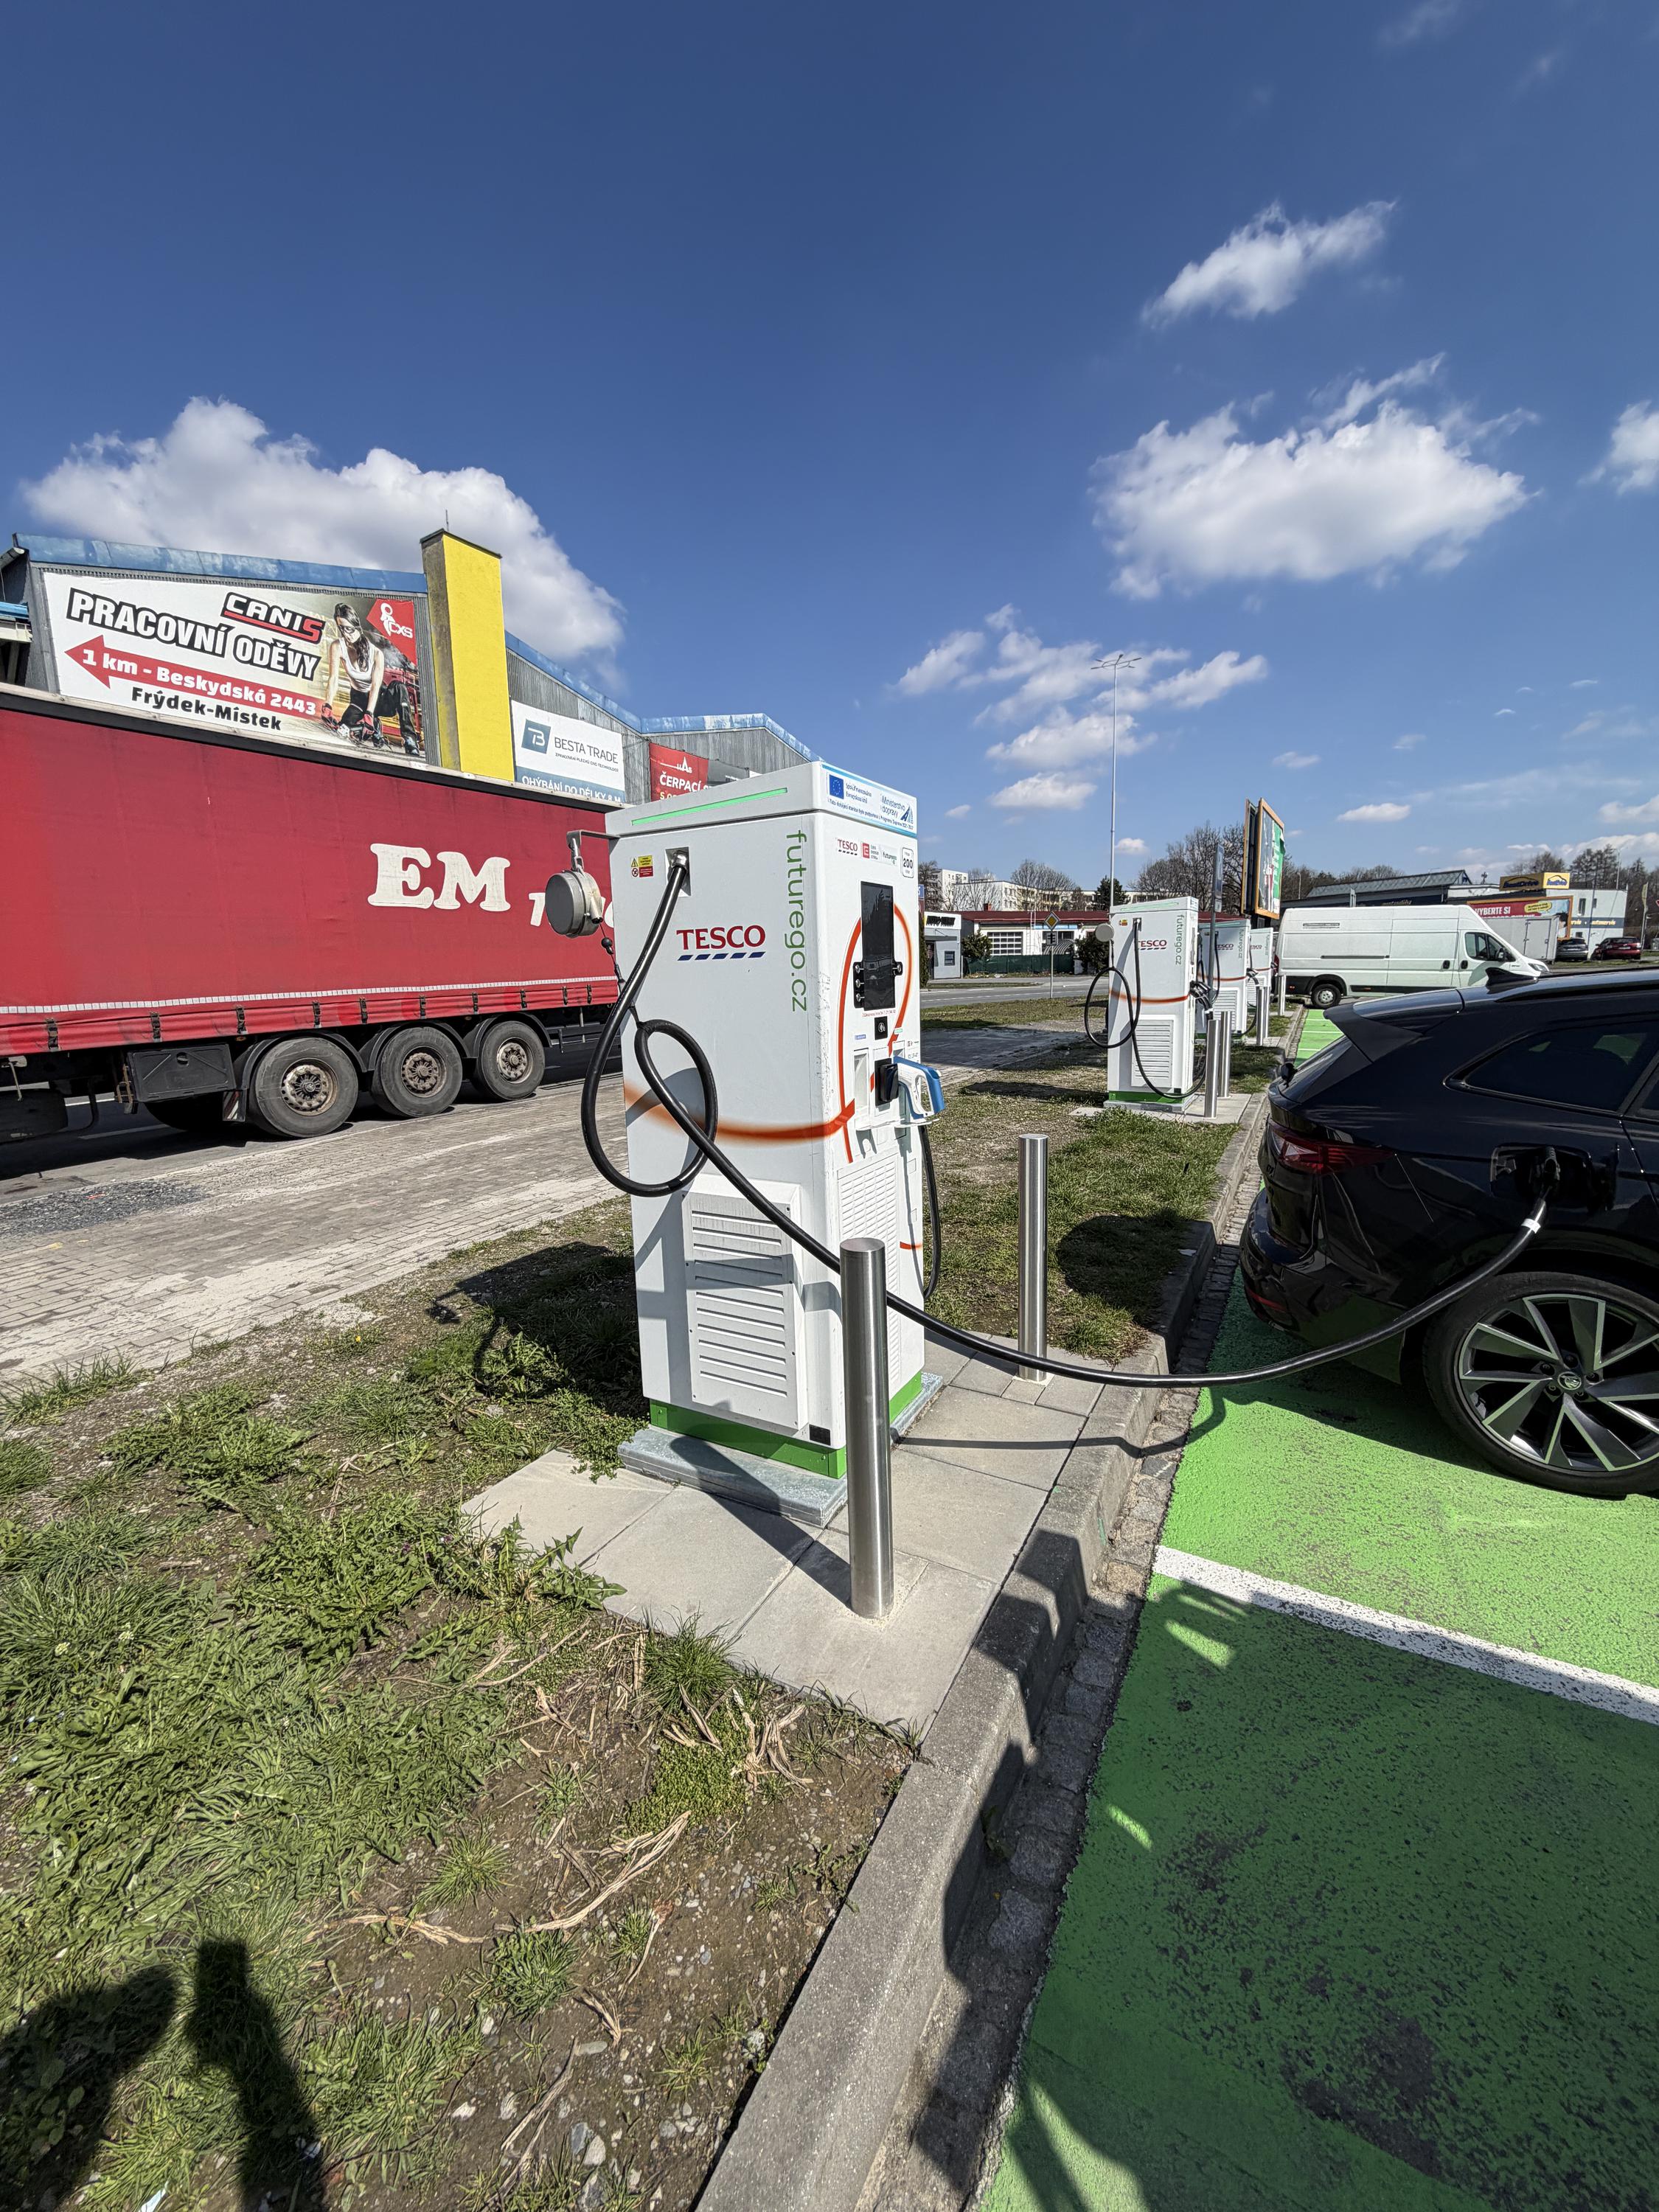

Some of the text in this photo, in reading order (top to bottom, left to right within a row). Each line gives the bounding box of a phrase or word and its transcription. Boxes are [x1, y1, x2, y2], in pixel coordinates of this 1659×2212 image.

[68, 589, 321, 680] PRACOVNÍ ODĚVY
[222, 593, 324, 642] CANIS
[389, 622, 413, 638] CXS
[83, 649, 97, 666] 1
[102, 653, 138, 675] km
[156, 667, 266, 704] Beskydská
[271, 693, 317, 715] 2443
[131, 686, 282, 730] Frýdek-Místek
[554, 737, 619, 764] BESTA TRADE
[659, 771, 702, 792] ČERPACÍ
[837, 838, 858, 852] TESCO
[902, 858, 914, 869] 200
[367, 843, 511, 912] EM
[676, 925, 765, 950] TESCO
[785, 830, 807, 1012] futurego.cz
[1175, 915, 1184, 965] futurego.cz
